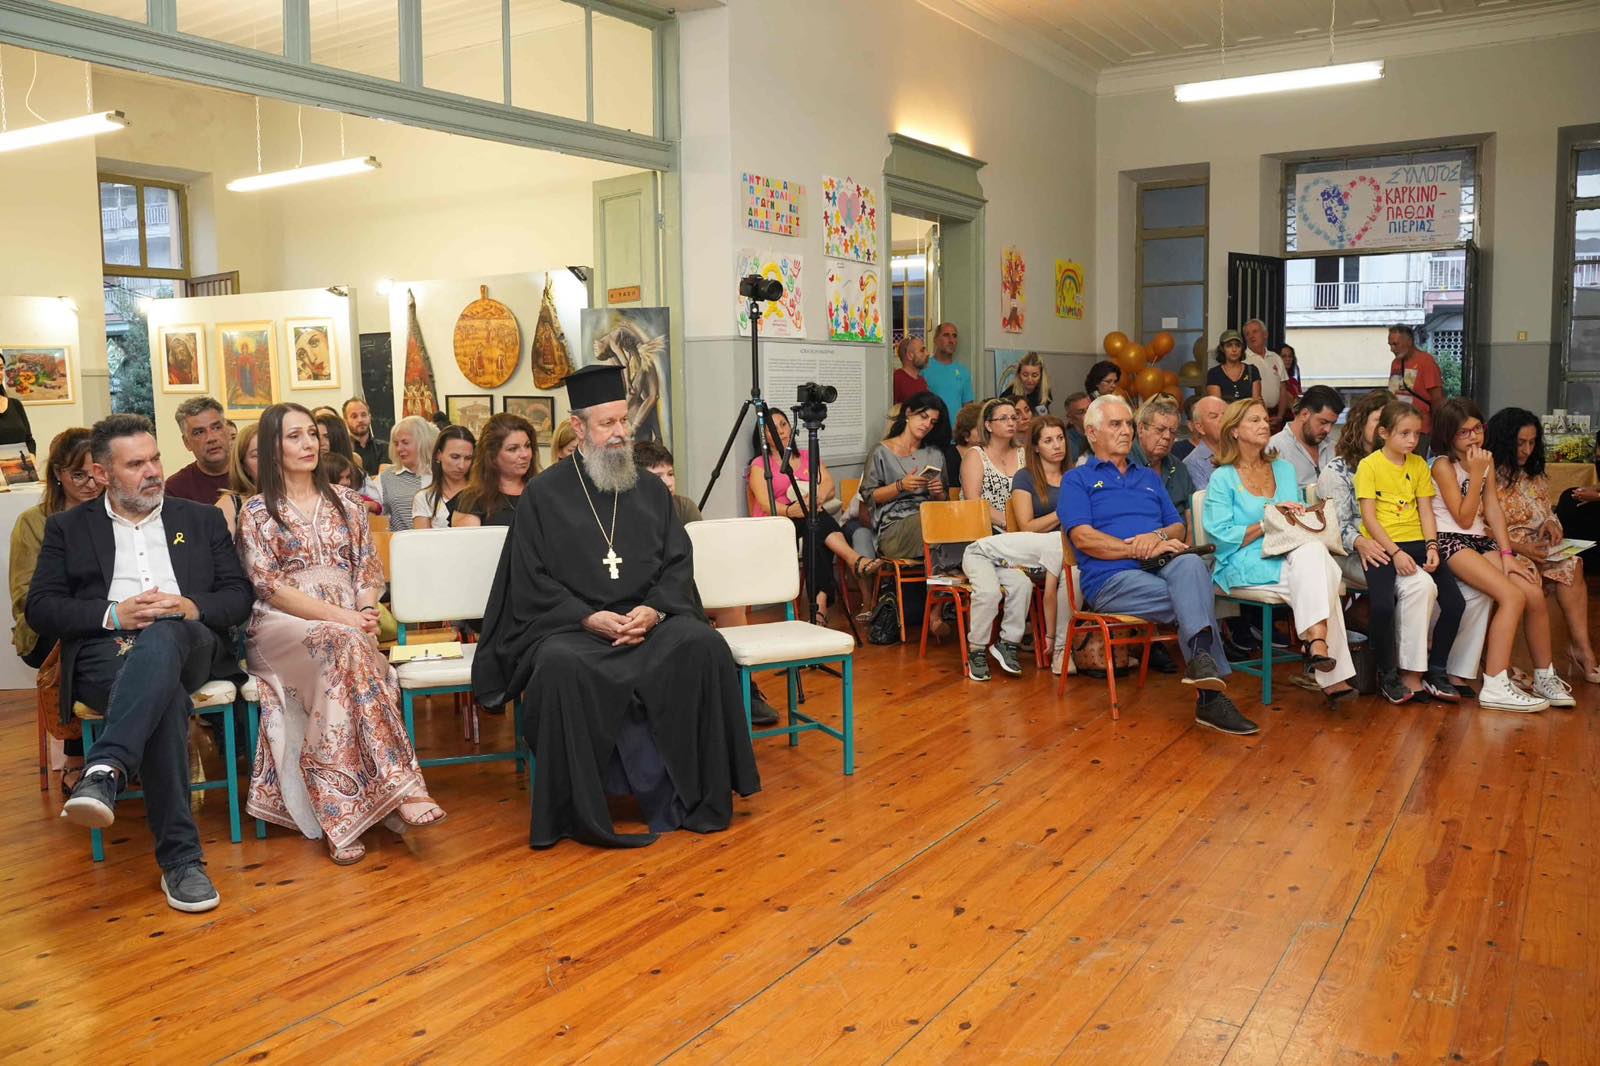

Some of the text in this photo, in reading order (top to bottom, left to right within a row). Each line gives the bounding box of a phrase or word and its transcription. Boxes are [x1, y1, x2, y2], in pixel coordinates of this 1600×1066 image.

[1385, 164, 1461, 184] ΣΥΛΛΟΓΟΣ
[1385, 185, 1447, 205] ΚΑΡΚΙΝΟ-
[1386, 204, 1435, 221] ΠΑΘΩΝ
[1389, 219, 1436, 234] ΠΙΕΡΙΑΣ
